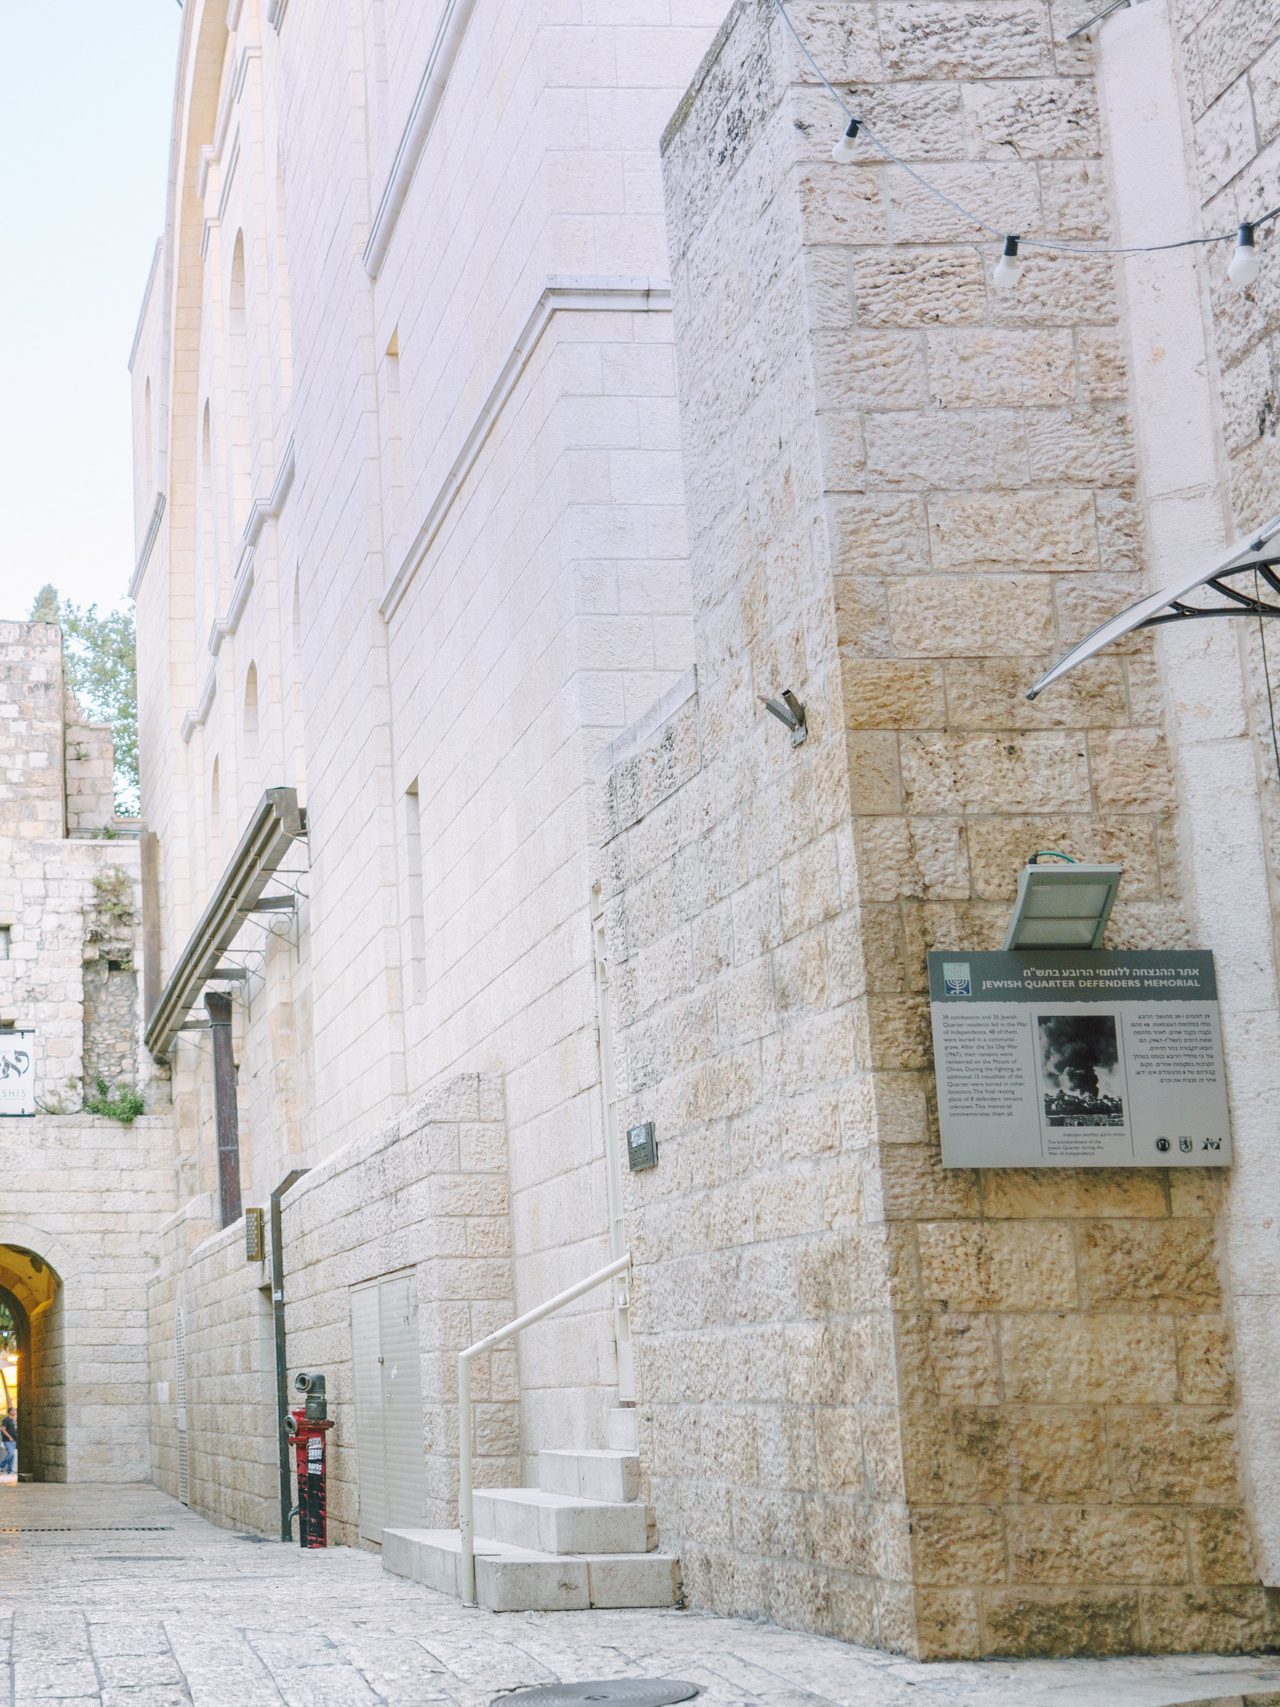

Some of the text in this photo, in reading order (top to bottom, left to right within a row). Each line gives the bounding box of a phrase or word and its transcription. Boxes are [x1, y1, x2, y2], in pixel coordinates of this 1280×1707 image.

[1023, 967, 1199, 976] אתר ההנצחה ללוחמי הרובע בתש"ח
[982, 980, 1022, 989] JEWISH
[1024, 980, 1074, 989] QUARTER
